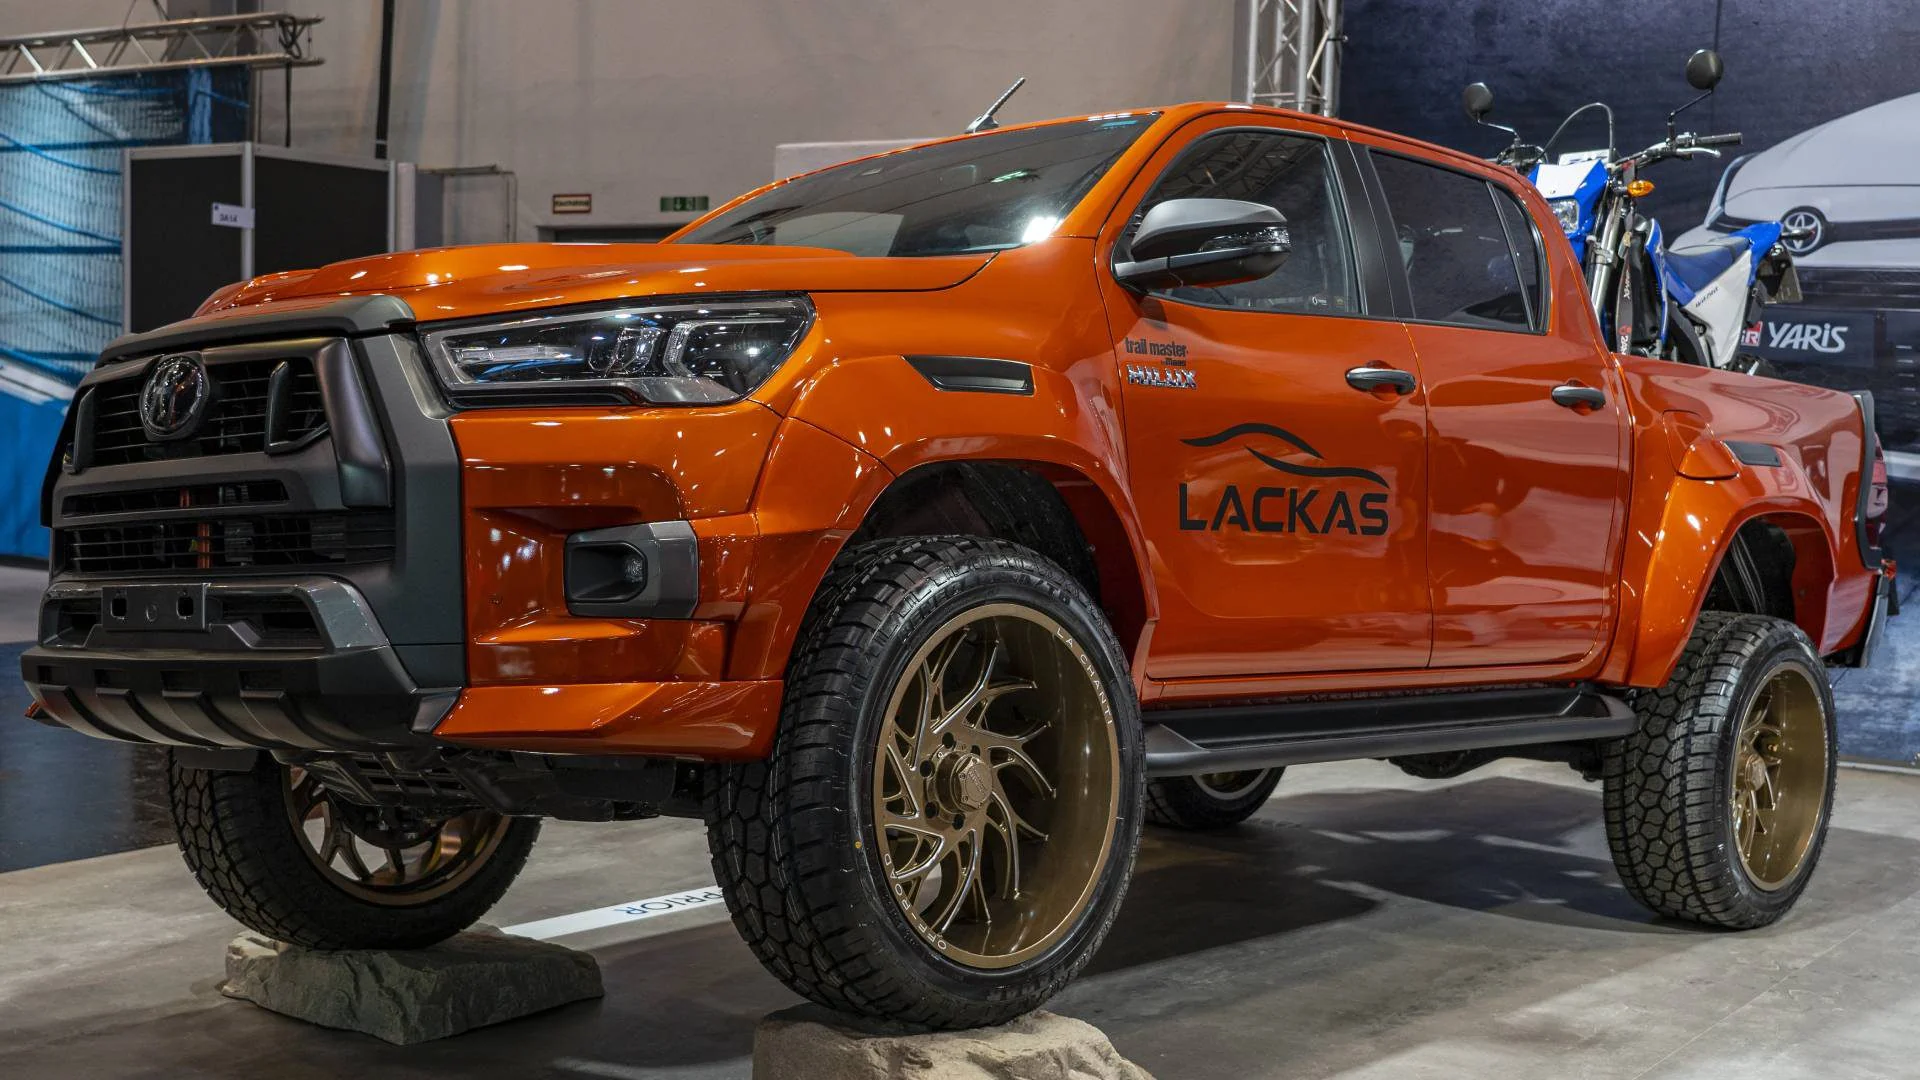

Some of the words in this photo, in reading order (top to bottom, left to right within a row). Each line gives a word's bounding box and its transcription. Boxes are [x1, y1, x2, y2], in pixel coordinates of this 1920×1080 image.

[1125, 336, 1148, 354] trail
[1149, 341, 1187, 357] master
[1126, 364, 1197, 390] HILUX
[1179, 483, 1389, 536] LACKAS
[1056, 627, 1073, 648] LA
[1080, 654, 1113, 725] CHANTI
[614, 891, 723, 915] PRIOR
